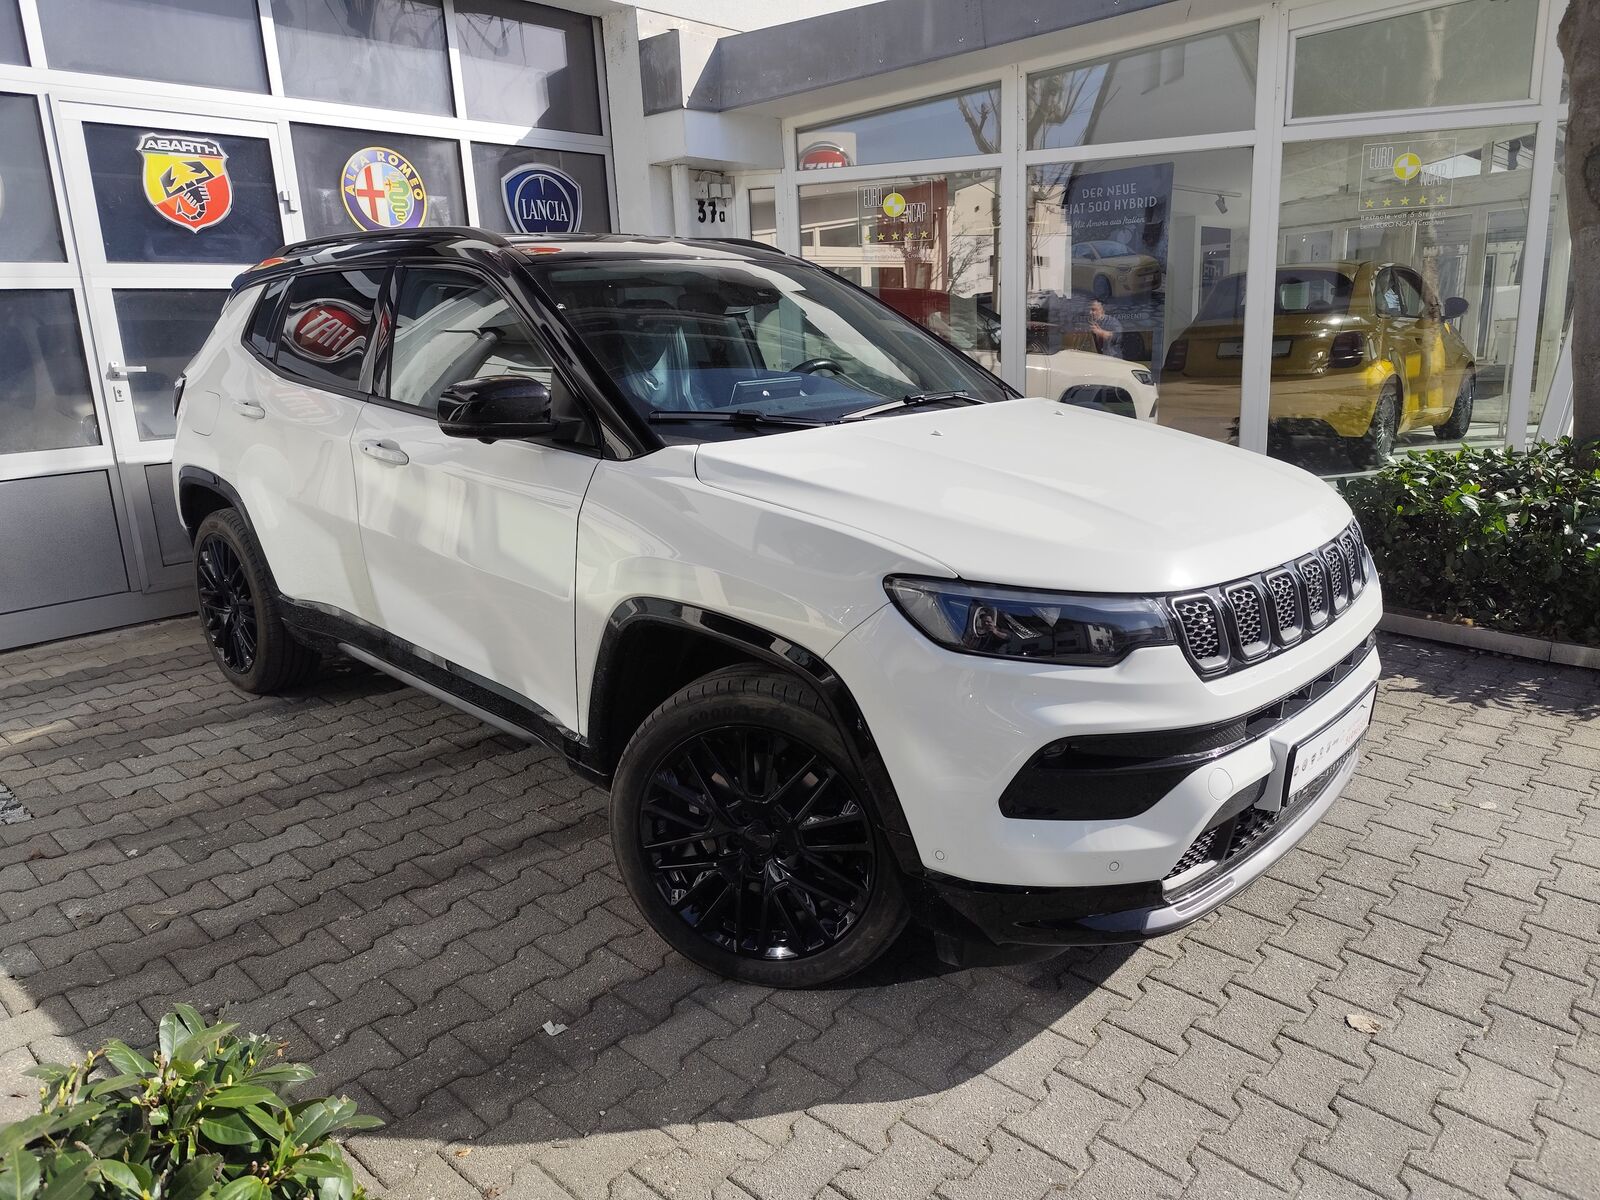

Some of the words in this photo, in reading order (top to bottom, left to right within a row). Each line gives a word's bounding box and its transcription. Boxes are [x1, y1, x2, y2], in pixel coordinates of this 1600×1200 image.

[144, 139, 218, 155] ABARTH
[1369, 146, 1394, 169] EURO
[344, 155, 370, 196] ALFA
[376, 151, 424, 200] ROMEO
[863, 186, 883, 208] EURO
[1082, 187, 1103, 199] DER
[1106, 182, 1137, 196] NEUE
[521, 198, 569, 222] LANCIA
[905, 202, 927, 223] NCAP
[1063, 202, 1086, 215] FIAT
[1088, 200, 1111, 213] 500
[1114, 196, 1157, 211] HYBRID
